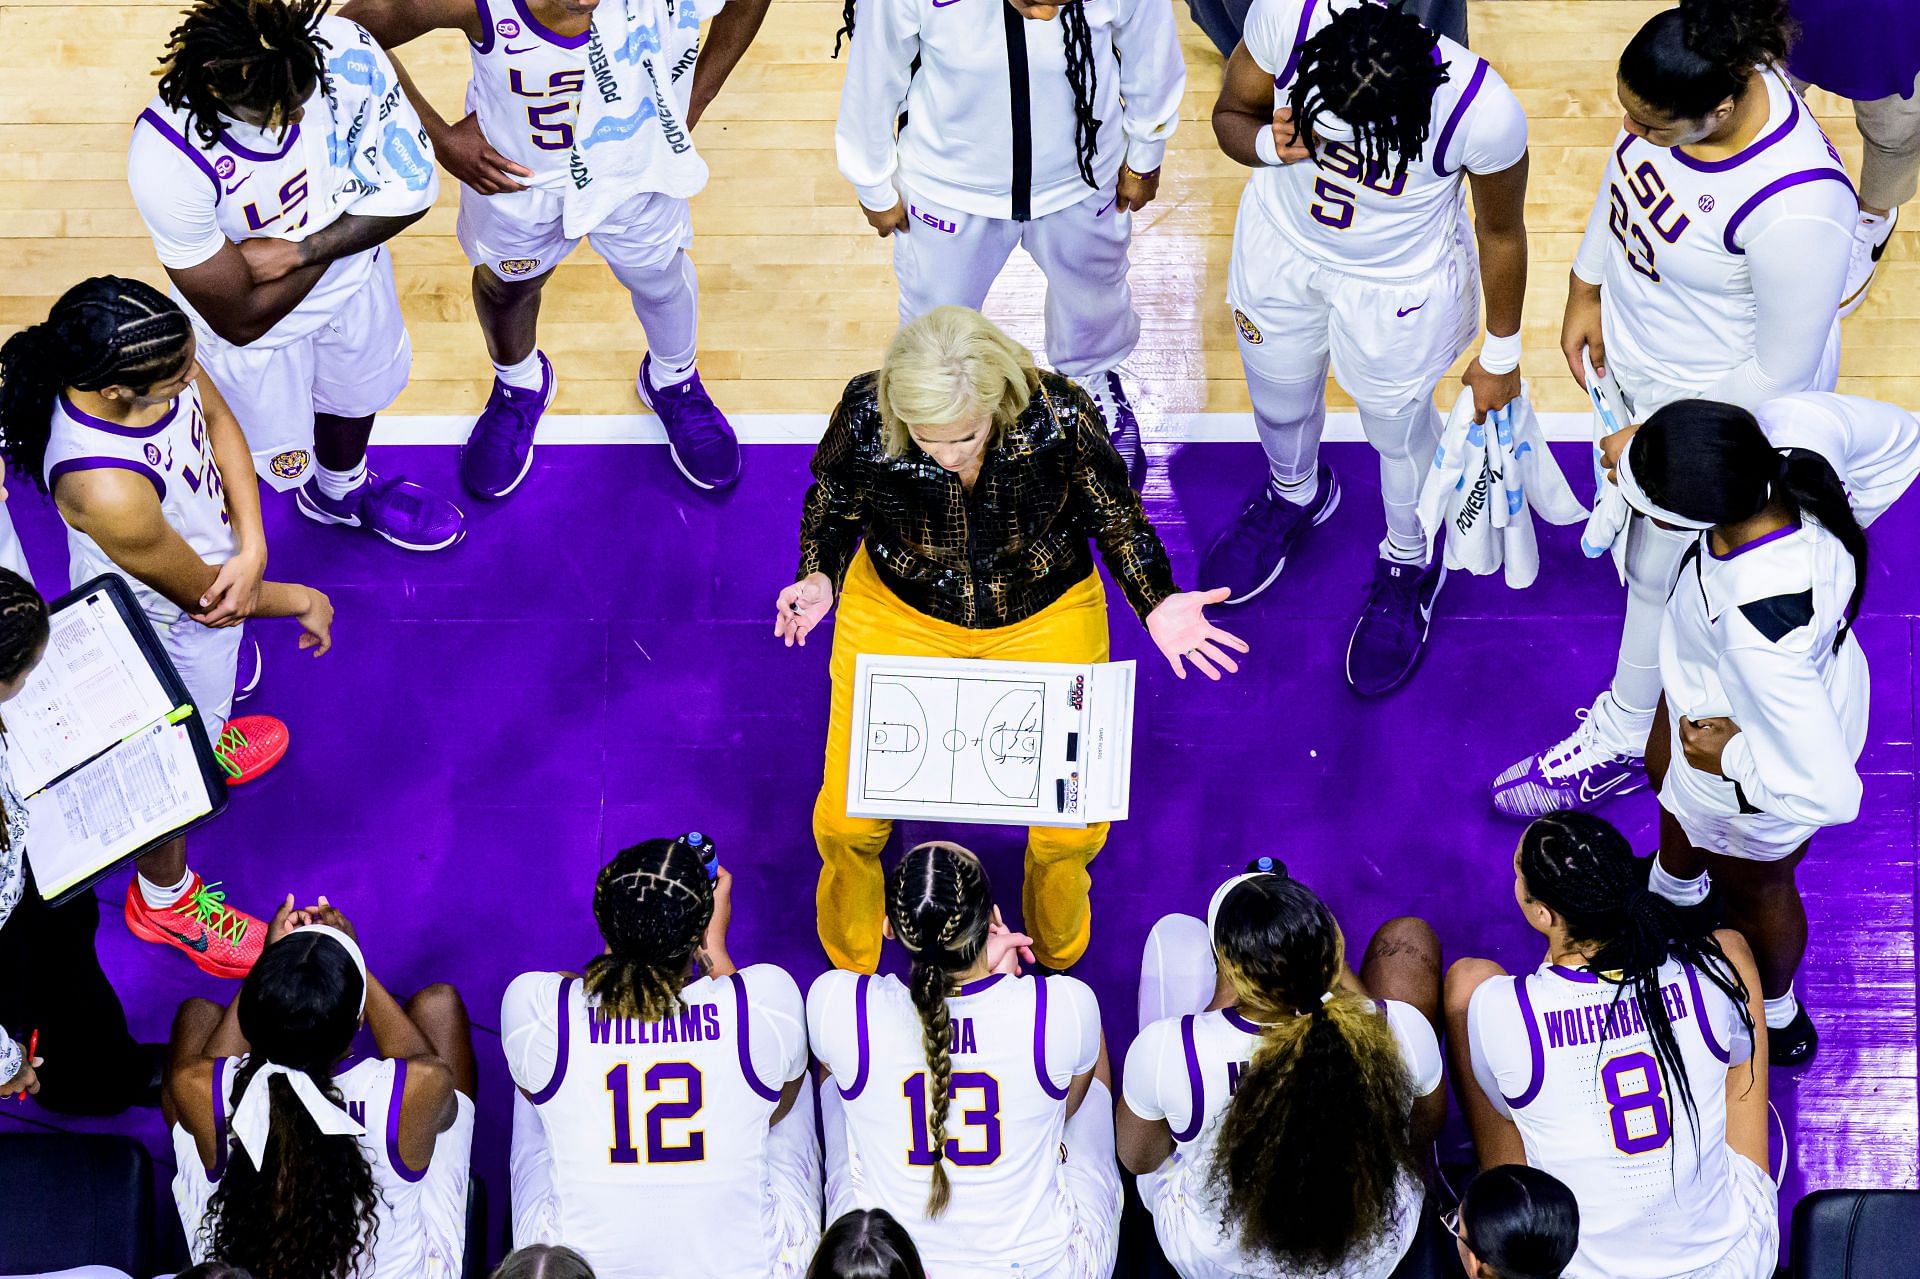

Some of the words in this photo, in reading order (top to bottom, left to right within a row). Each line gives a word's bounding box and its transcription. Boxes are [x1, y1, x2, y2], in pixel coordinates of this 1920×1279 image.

[508, 67, 586, 98] LS
[242, 167, 308, 232] LS
[1319, 139, 1410, 198] SU
[1615, 131, 1692, 245] LSU
[911, 204, 957, 234] LSU
[1310, 175, 1357, 231] 5
[1608, 181, 1661, 284] 23
[588, 1003, 721, 1045] WILLIAMS
[1543, 982, 1688, 1049] WOLFENBAER
[605, 1062, 706, 1165] 12
[902, 1070, 1002, 1168] 13
[1600, 1050, 1673, 1157] 8
